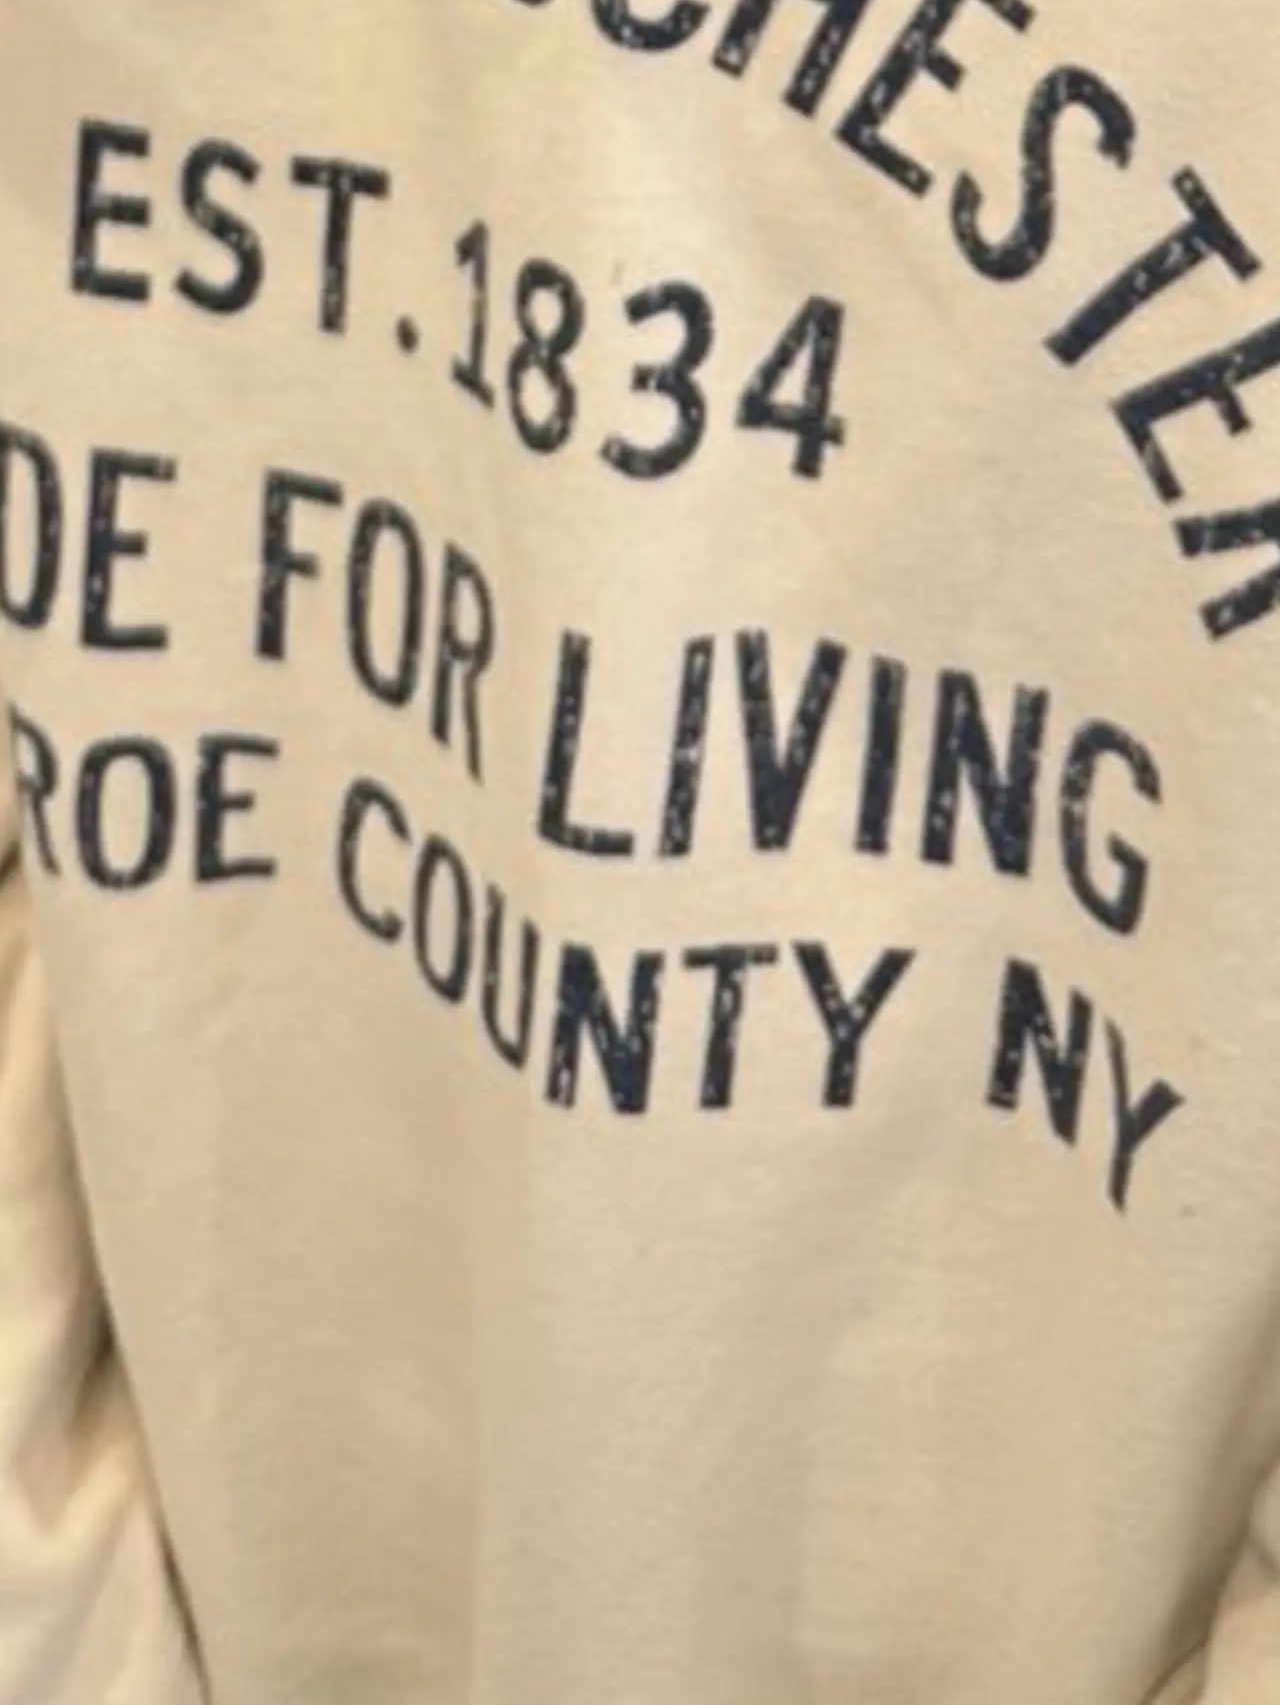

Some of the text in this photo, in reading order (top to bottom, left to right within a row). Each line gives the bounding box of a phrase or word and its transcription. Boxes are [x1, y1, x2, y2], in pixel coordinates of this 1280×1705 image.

[255, 469, 494, 781] FOR
[536, 631, 1162, 938] LIVING
[8, 703, 1184, 1213] ROE COUNTY NY
